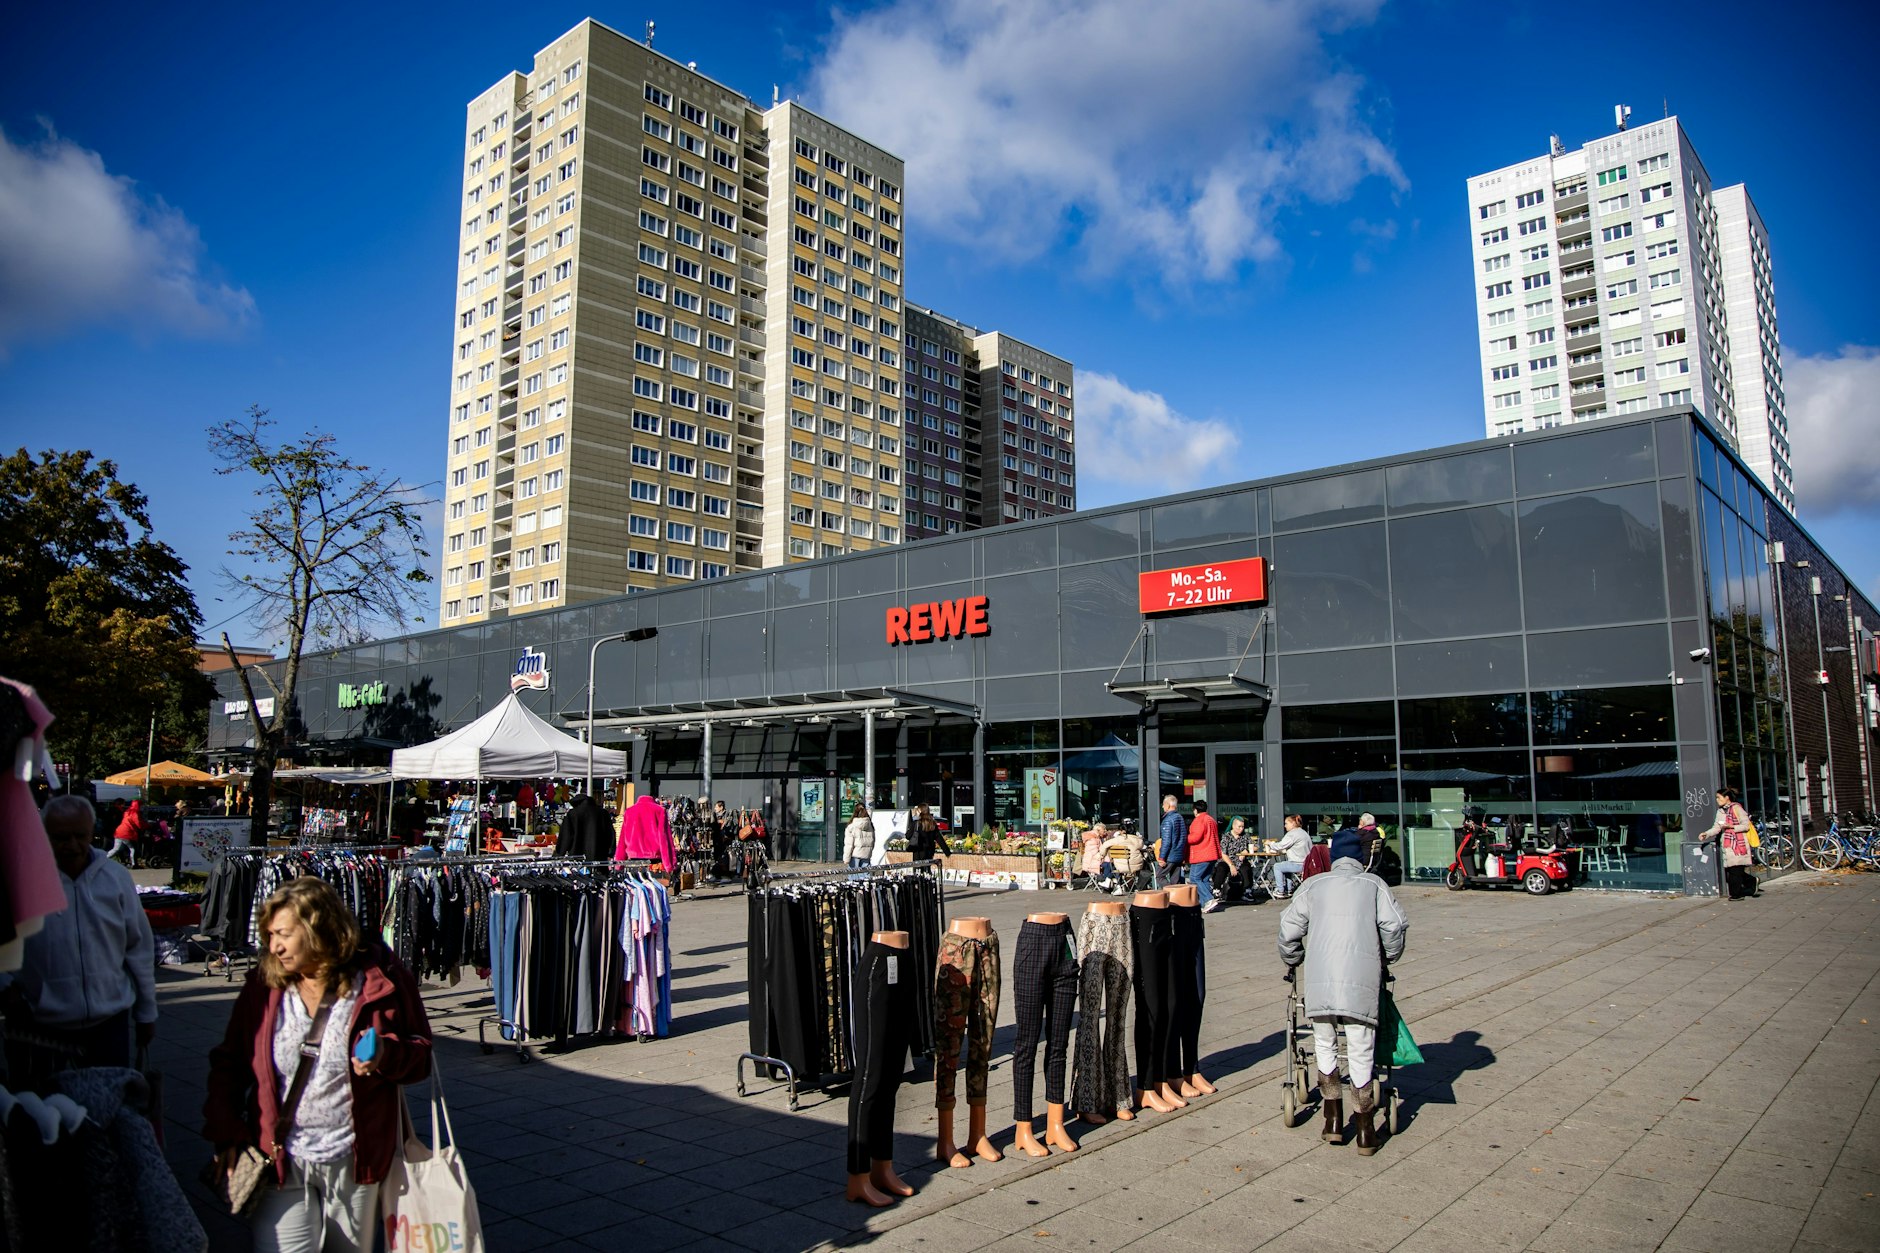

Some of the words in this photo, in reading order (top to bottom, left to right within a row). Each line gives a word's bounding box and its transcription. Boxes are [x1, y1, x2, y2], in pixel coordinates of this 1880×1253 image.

[1206, 586, 1232, 602] Uhr
[886, 595, 988, 644] REWE
[517, 647, 540, 674] dm
